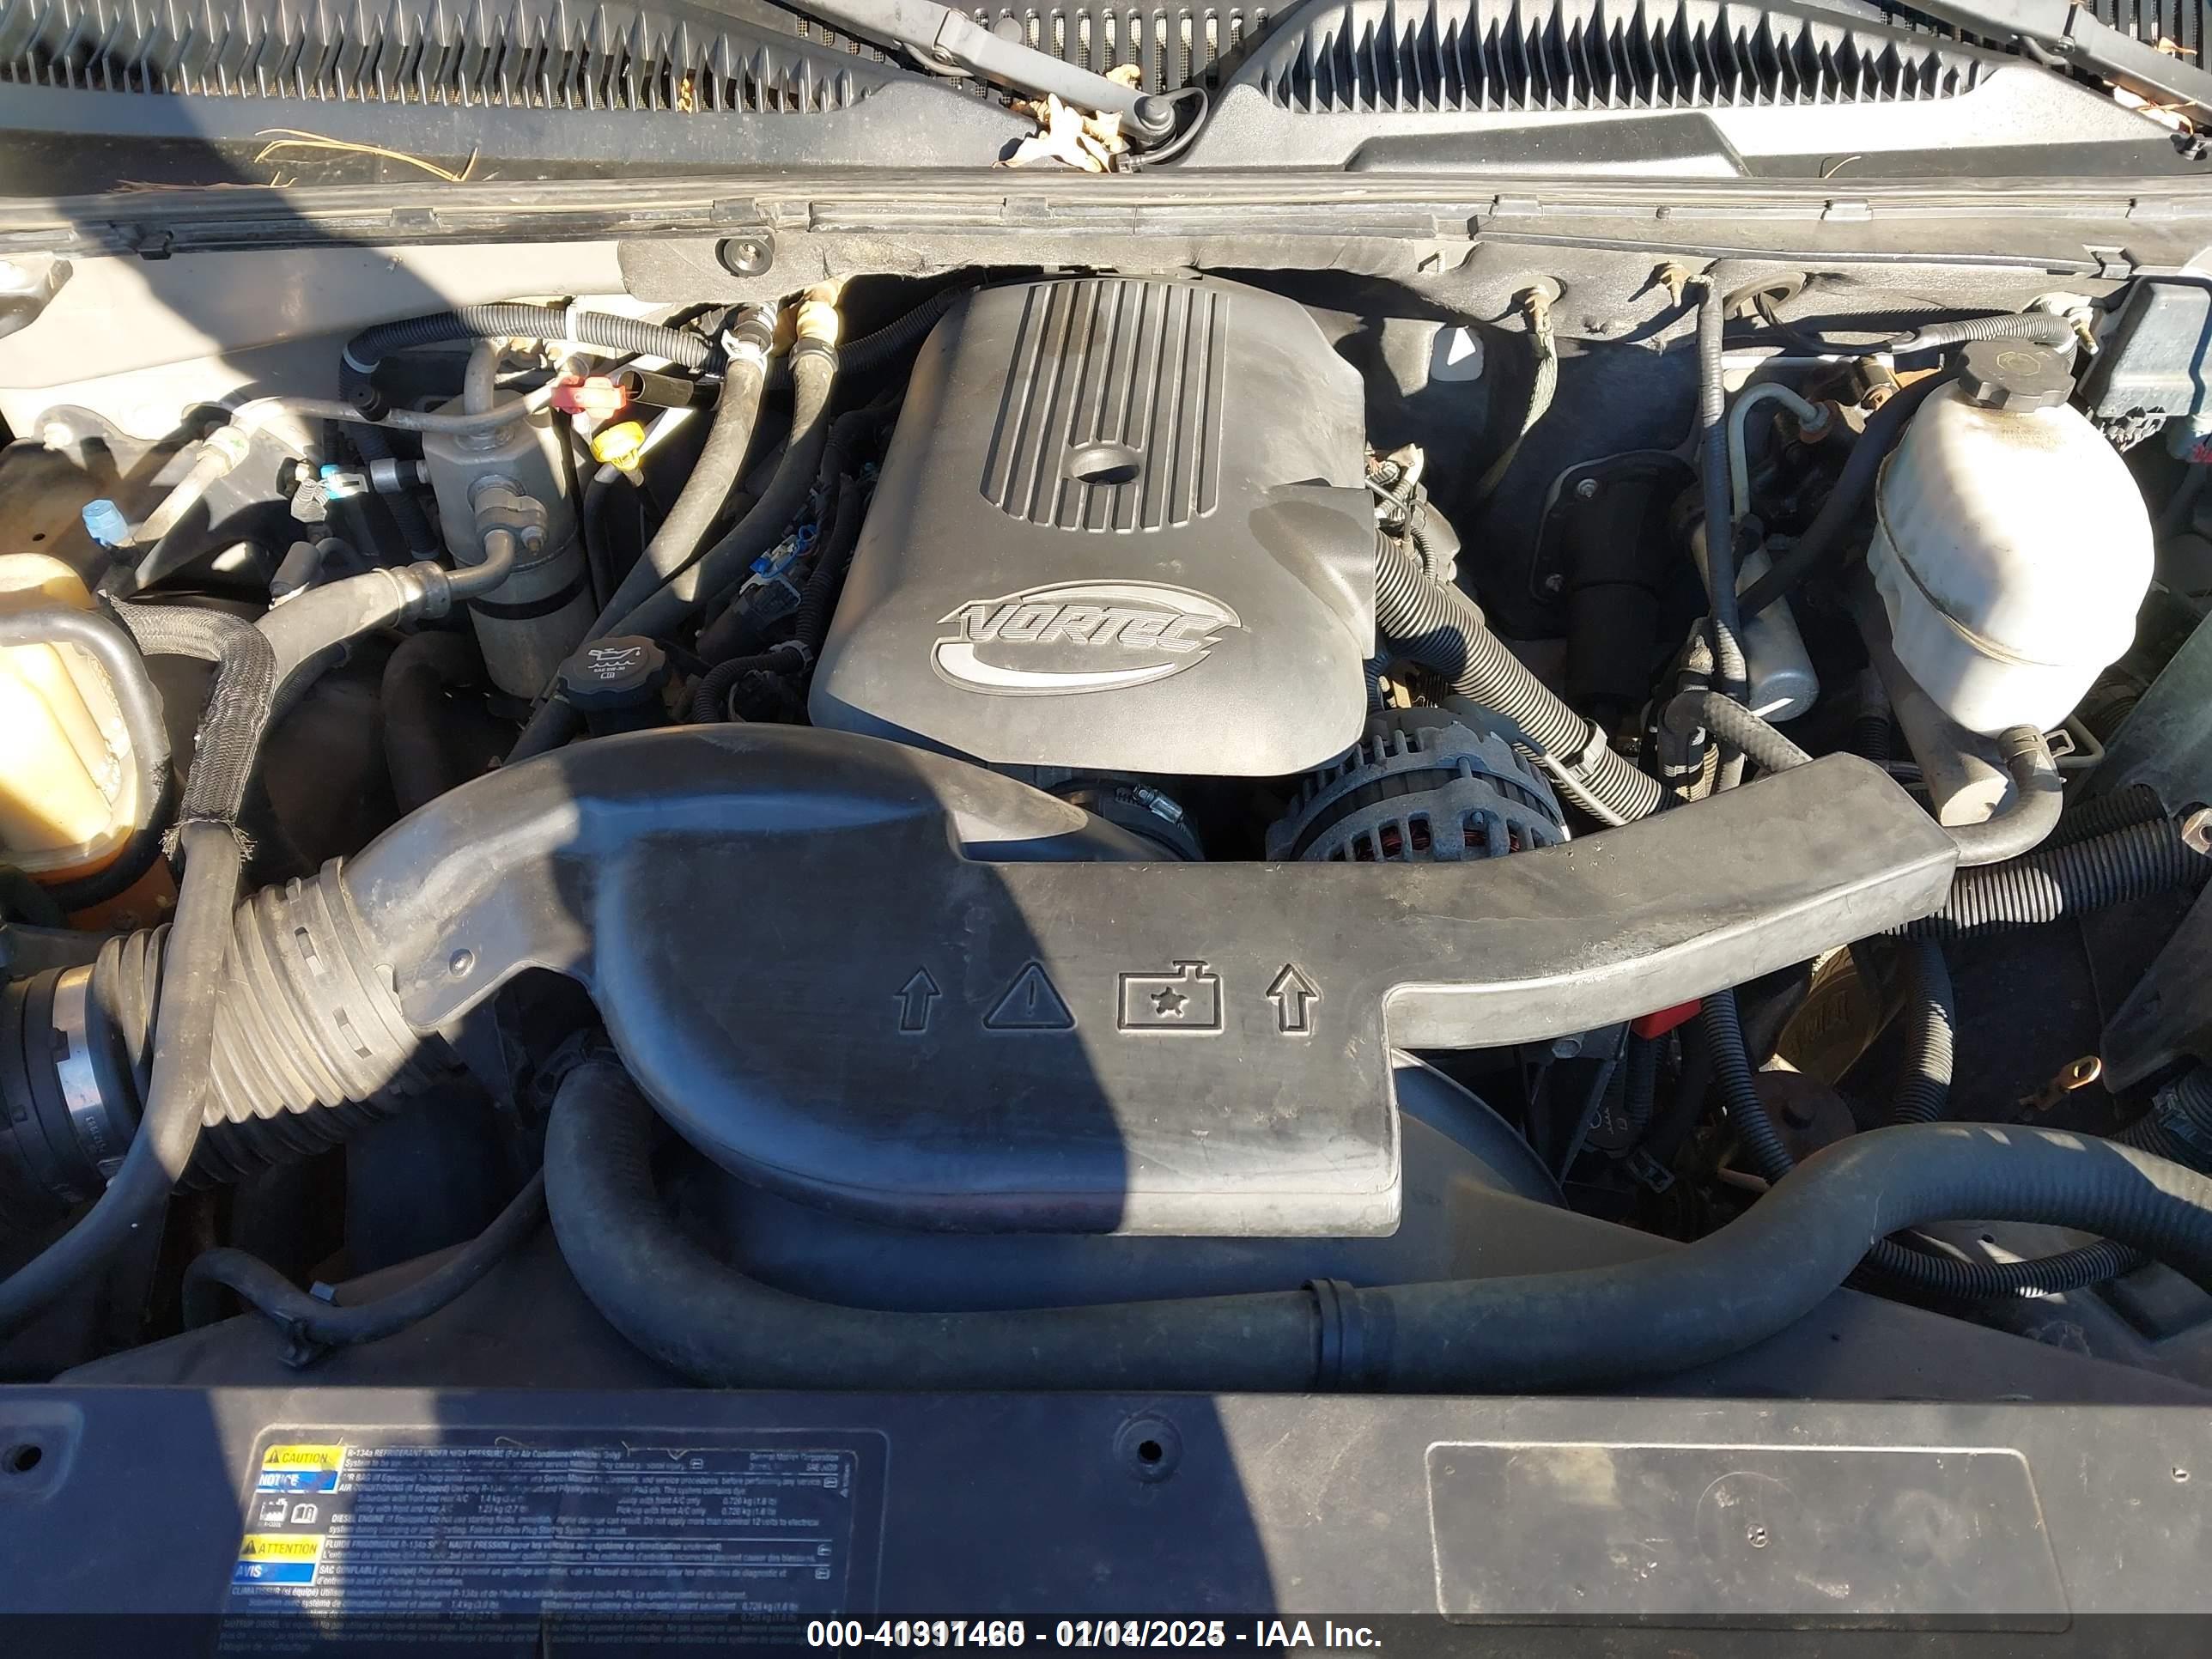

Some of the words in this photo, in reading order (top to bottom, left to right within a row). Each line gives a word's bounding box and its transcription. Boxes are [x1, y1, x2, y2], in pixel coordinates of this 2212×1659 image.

[961, 604, 1220, 653] VORTEC
[282, 1452, 328, 1463] CAUTION
[258, 1474, 301, 1486] NOTICE
[338, 1484, 351, 1492] AIR
[258, 1542, 318, 1555] ATTENTION
[234, 1565, 263, 1578] AVIS
